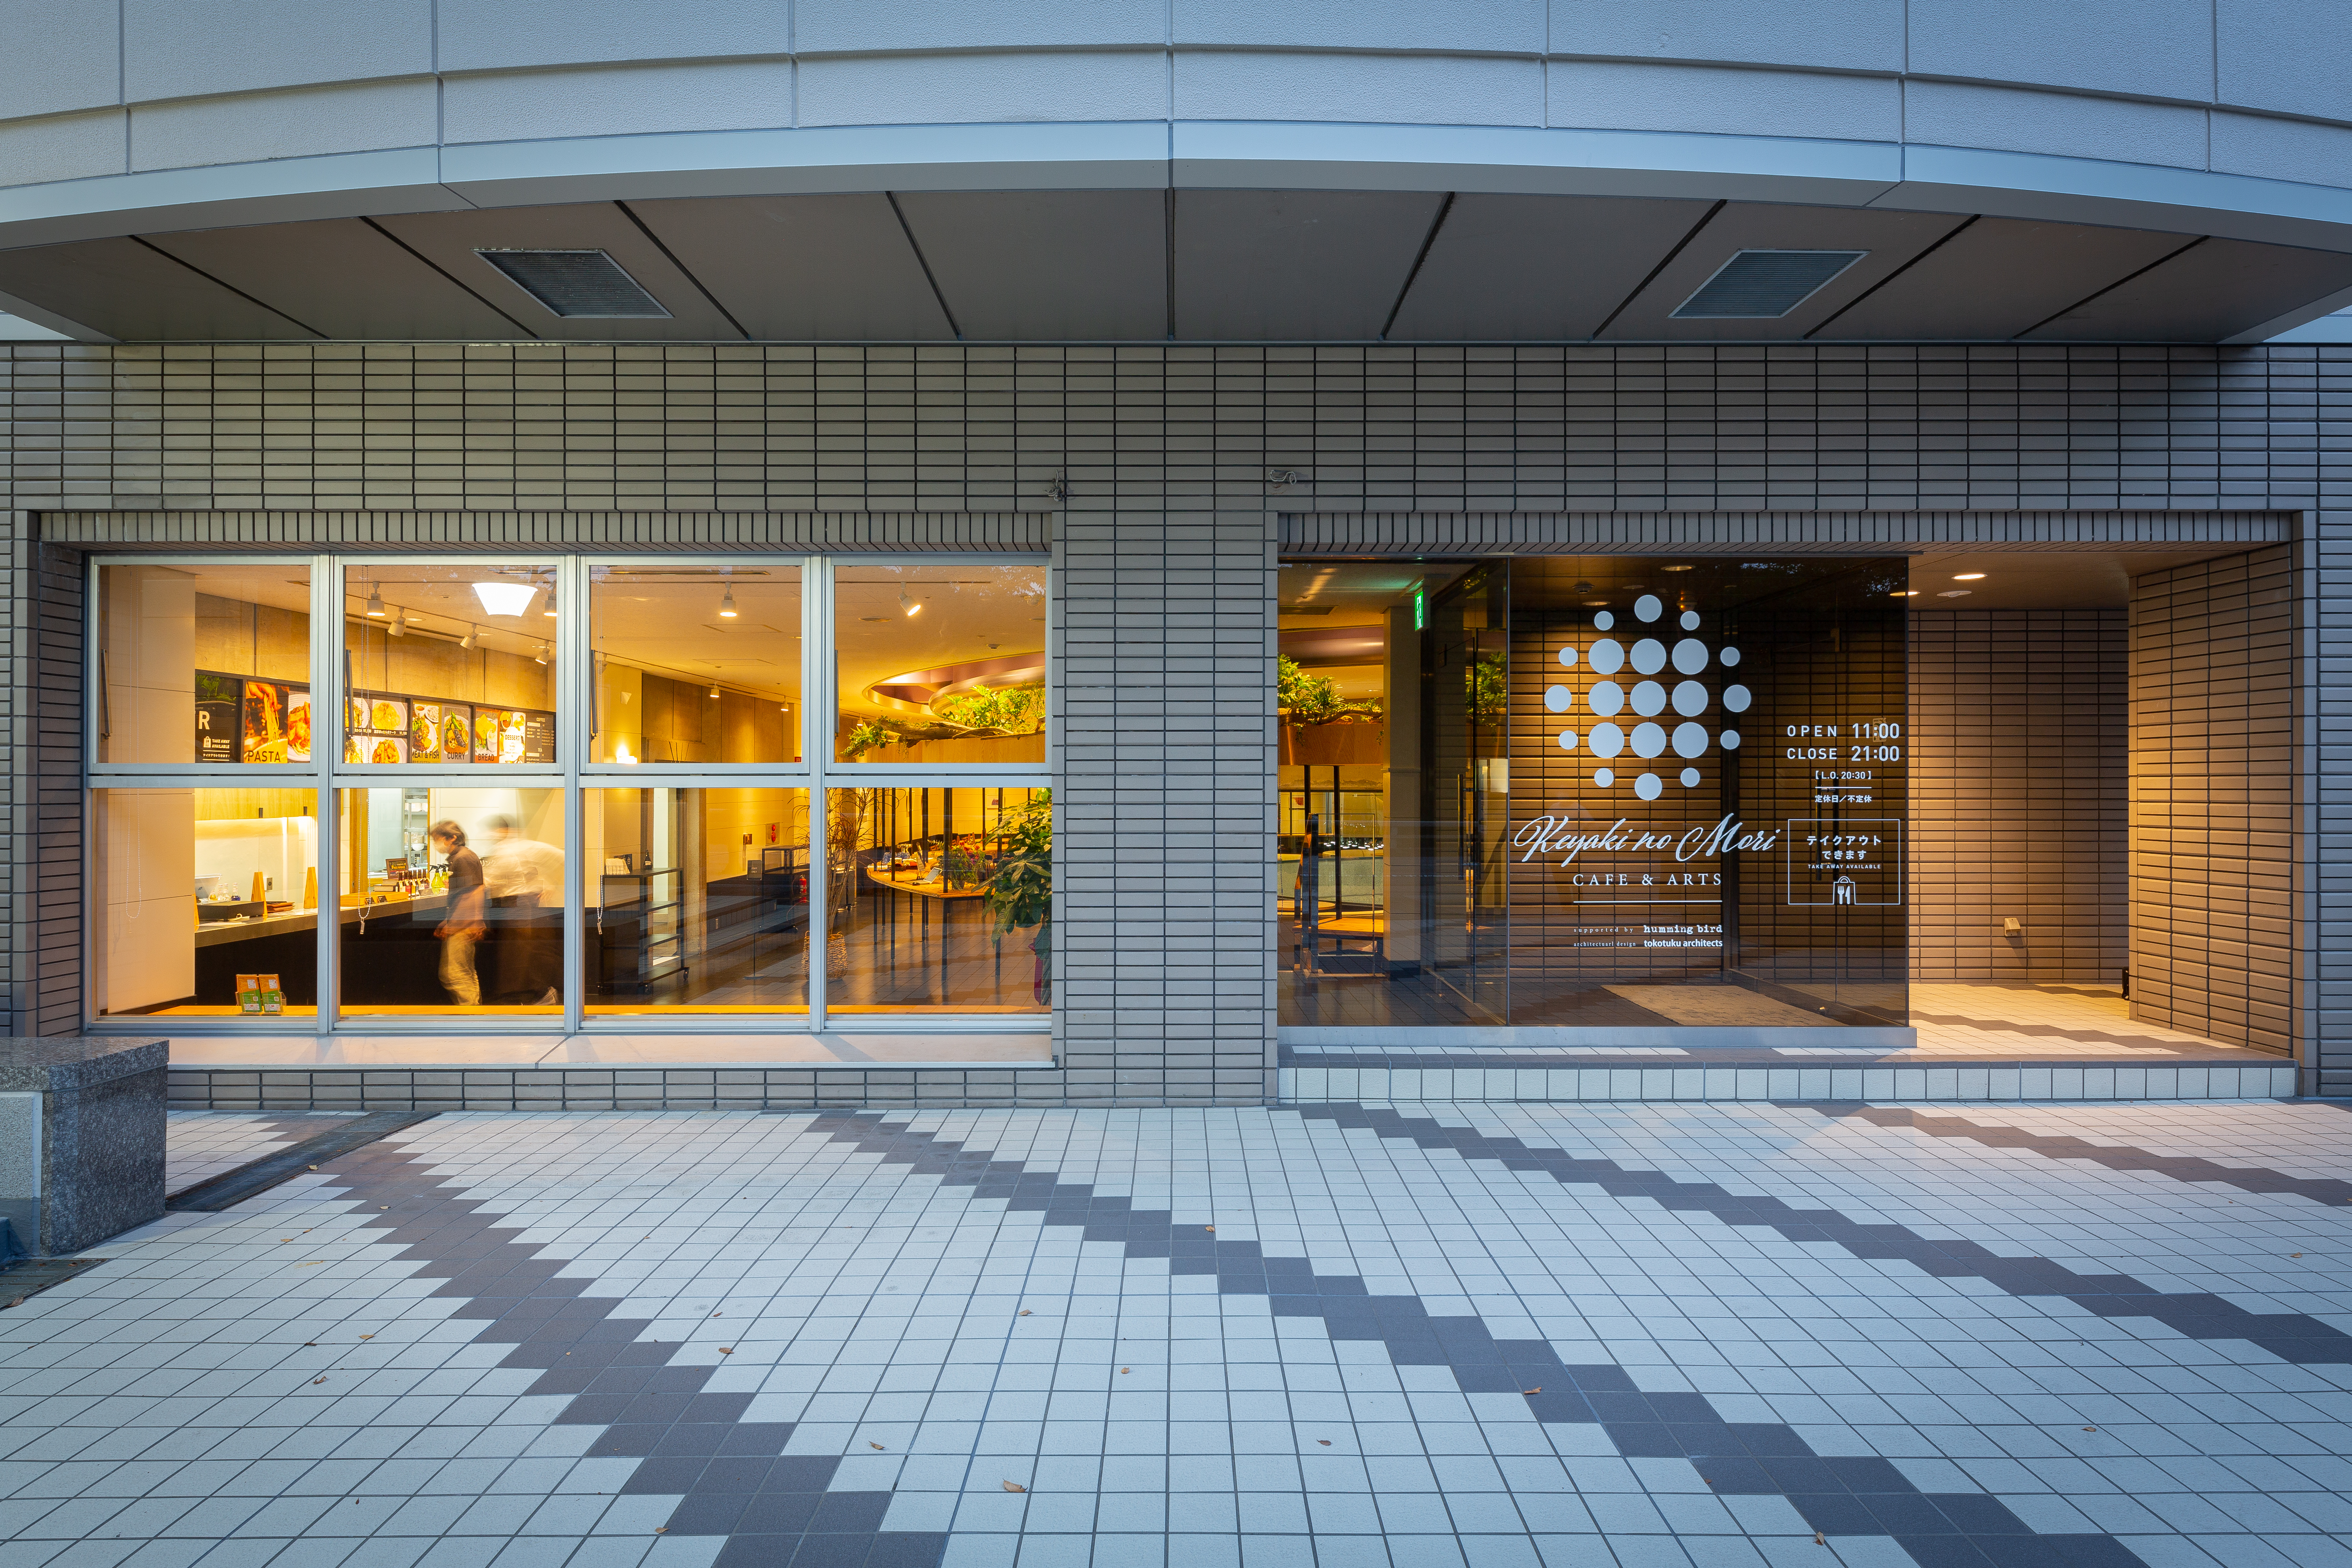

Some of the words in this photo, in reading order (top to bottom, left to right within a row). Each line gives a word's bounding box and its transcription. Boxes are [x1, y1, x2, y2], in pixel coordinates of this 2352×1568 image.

[1787, 725, 1837, 737] OPEN
[1852, 723, 1899, 739] 11:00
[248, 751, 281, 762] PASTA
[447, 752, 465, 760] CURRY
[1787, 748, 1837, 760] CLOSE
[1851, 746, 1899, 762] 21:00
[1815, 795, 1872, 803] 定休日／不定休
[1514, 815, 1634, 867] Keyaki
[1633, 833, 1672, 851] no
[1675, 813, 1781, 862] Mori
[1806, 835, 1881, 846] テイクアウト
[1822, 850, 1866, 860] できます
[1573, 874, 1628, 886] CAFE
[1642, 873, 1654, 886] &
[1666, 873, 1721, 885] ARTS
[1643, 924, 1694, 935] humming
[1696, 924, 1723, 933] bird
[1644, 939, 1682, 947] tokotuku
[1683, 938, 1723, 947] architects
